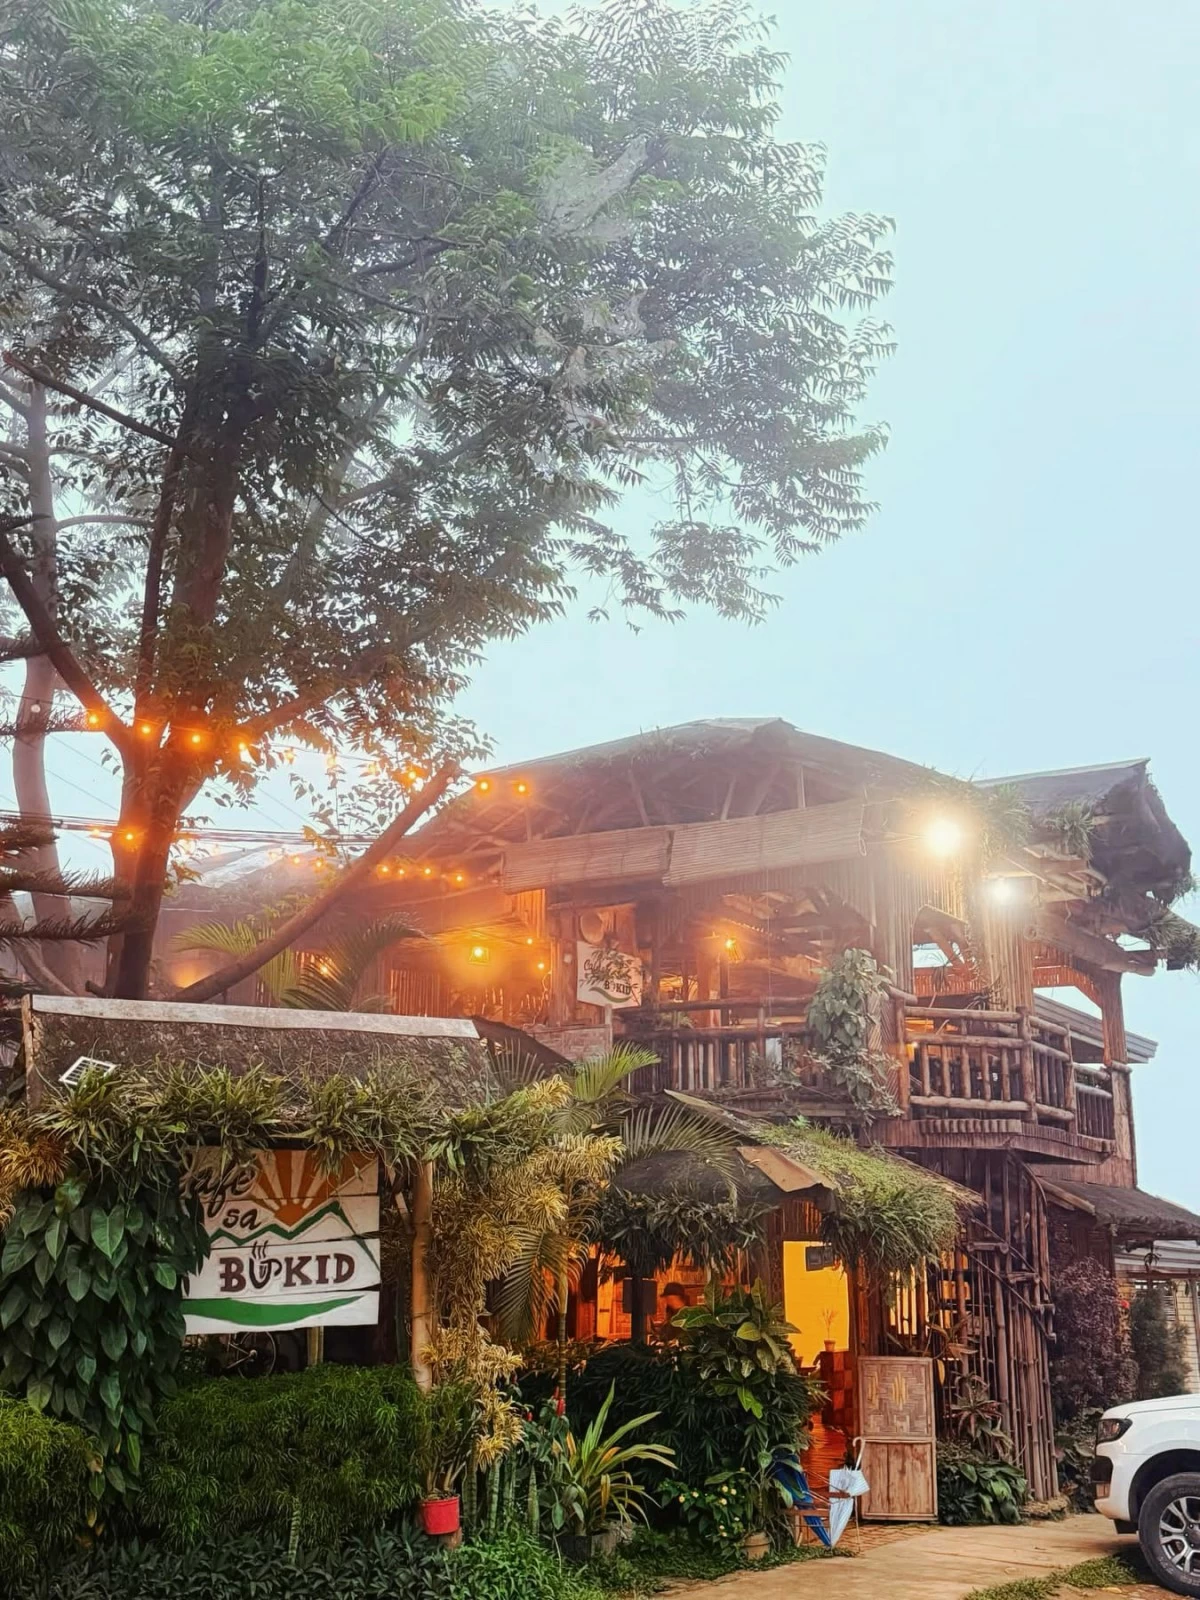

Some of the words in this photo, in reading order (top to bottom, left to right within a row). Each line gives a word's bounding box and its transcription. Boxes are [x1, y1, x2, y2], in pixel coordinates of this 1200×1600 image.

[181, 1151, 256, 1218] afe
[223, 1208, 261, 1231] sa
[219, 1252, 356, 1293] BUKID
